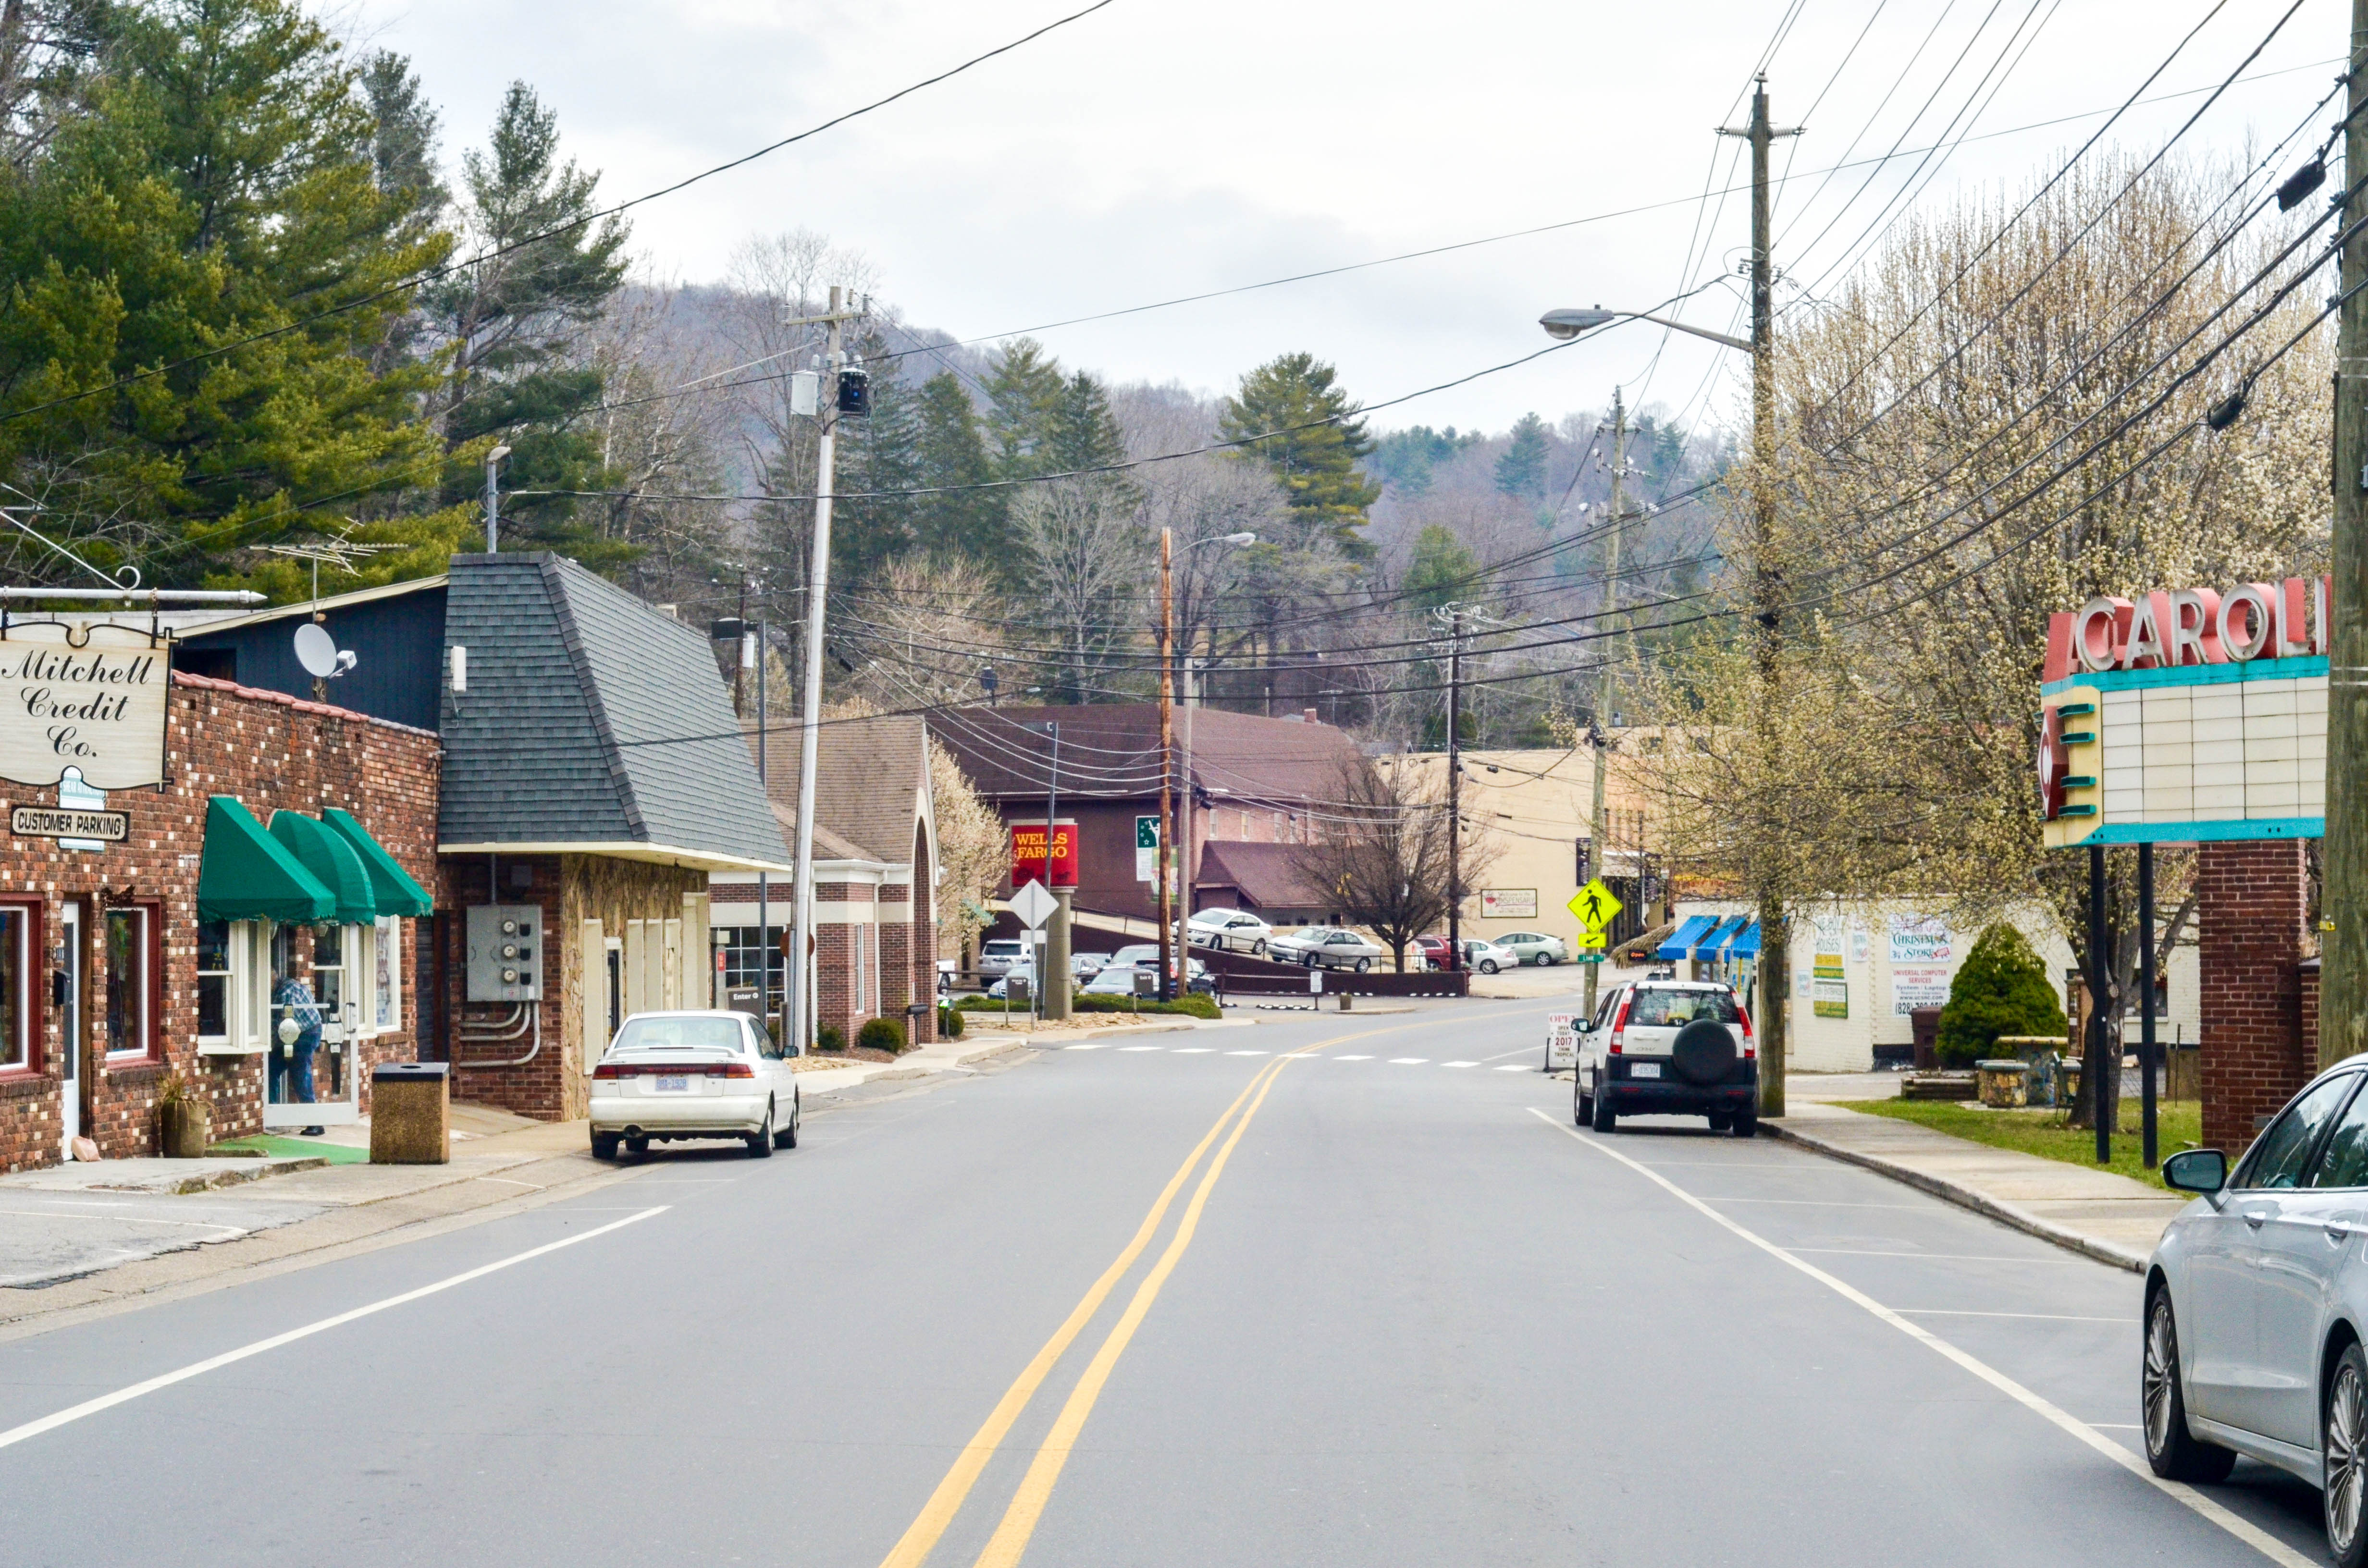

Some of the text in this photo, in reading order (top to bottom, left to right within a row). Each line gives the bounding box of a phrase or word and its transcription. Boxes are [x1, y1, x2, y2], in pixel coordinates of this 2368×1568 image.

[2, 649, 154, 685] Mitchell
[21, 687, 129, 721] Credit
[47, 725, 97, 757] Co.
[18, 811, 121, 835] CUSTOMER PARKING
[1017, 846, 1068, 858] FARGO
[1896, 1003, 1912, 1015] (828)
